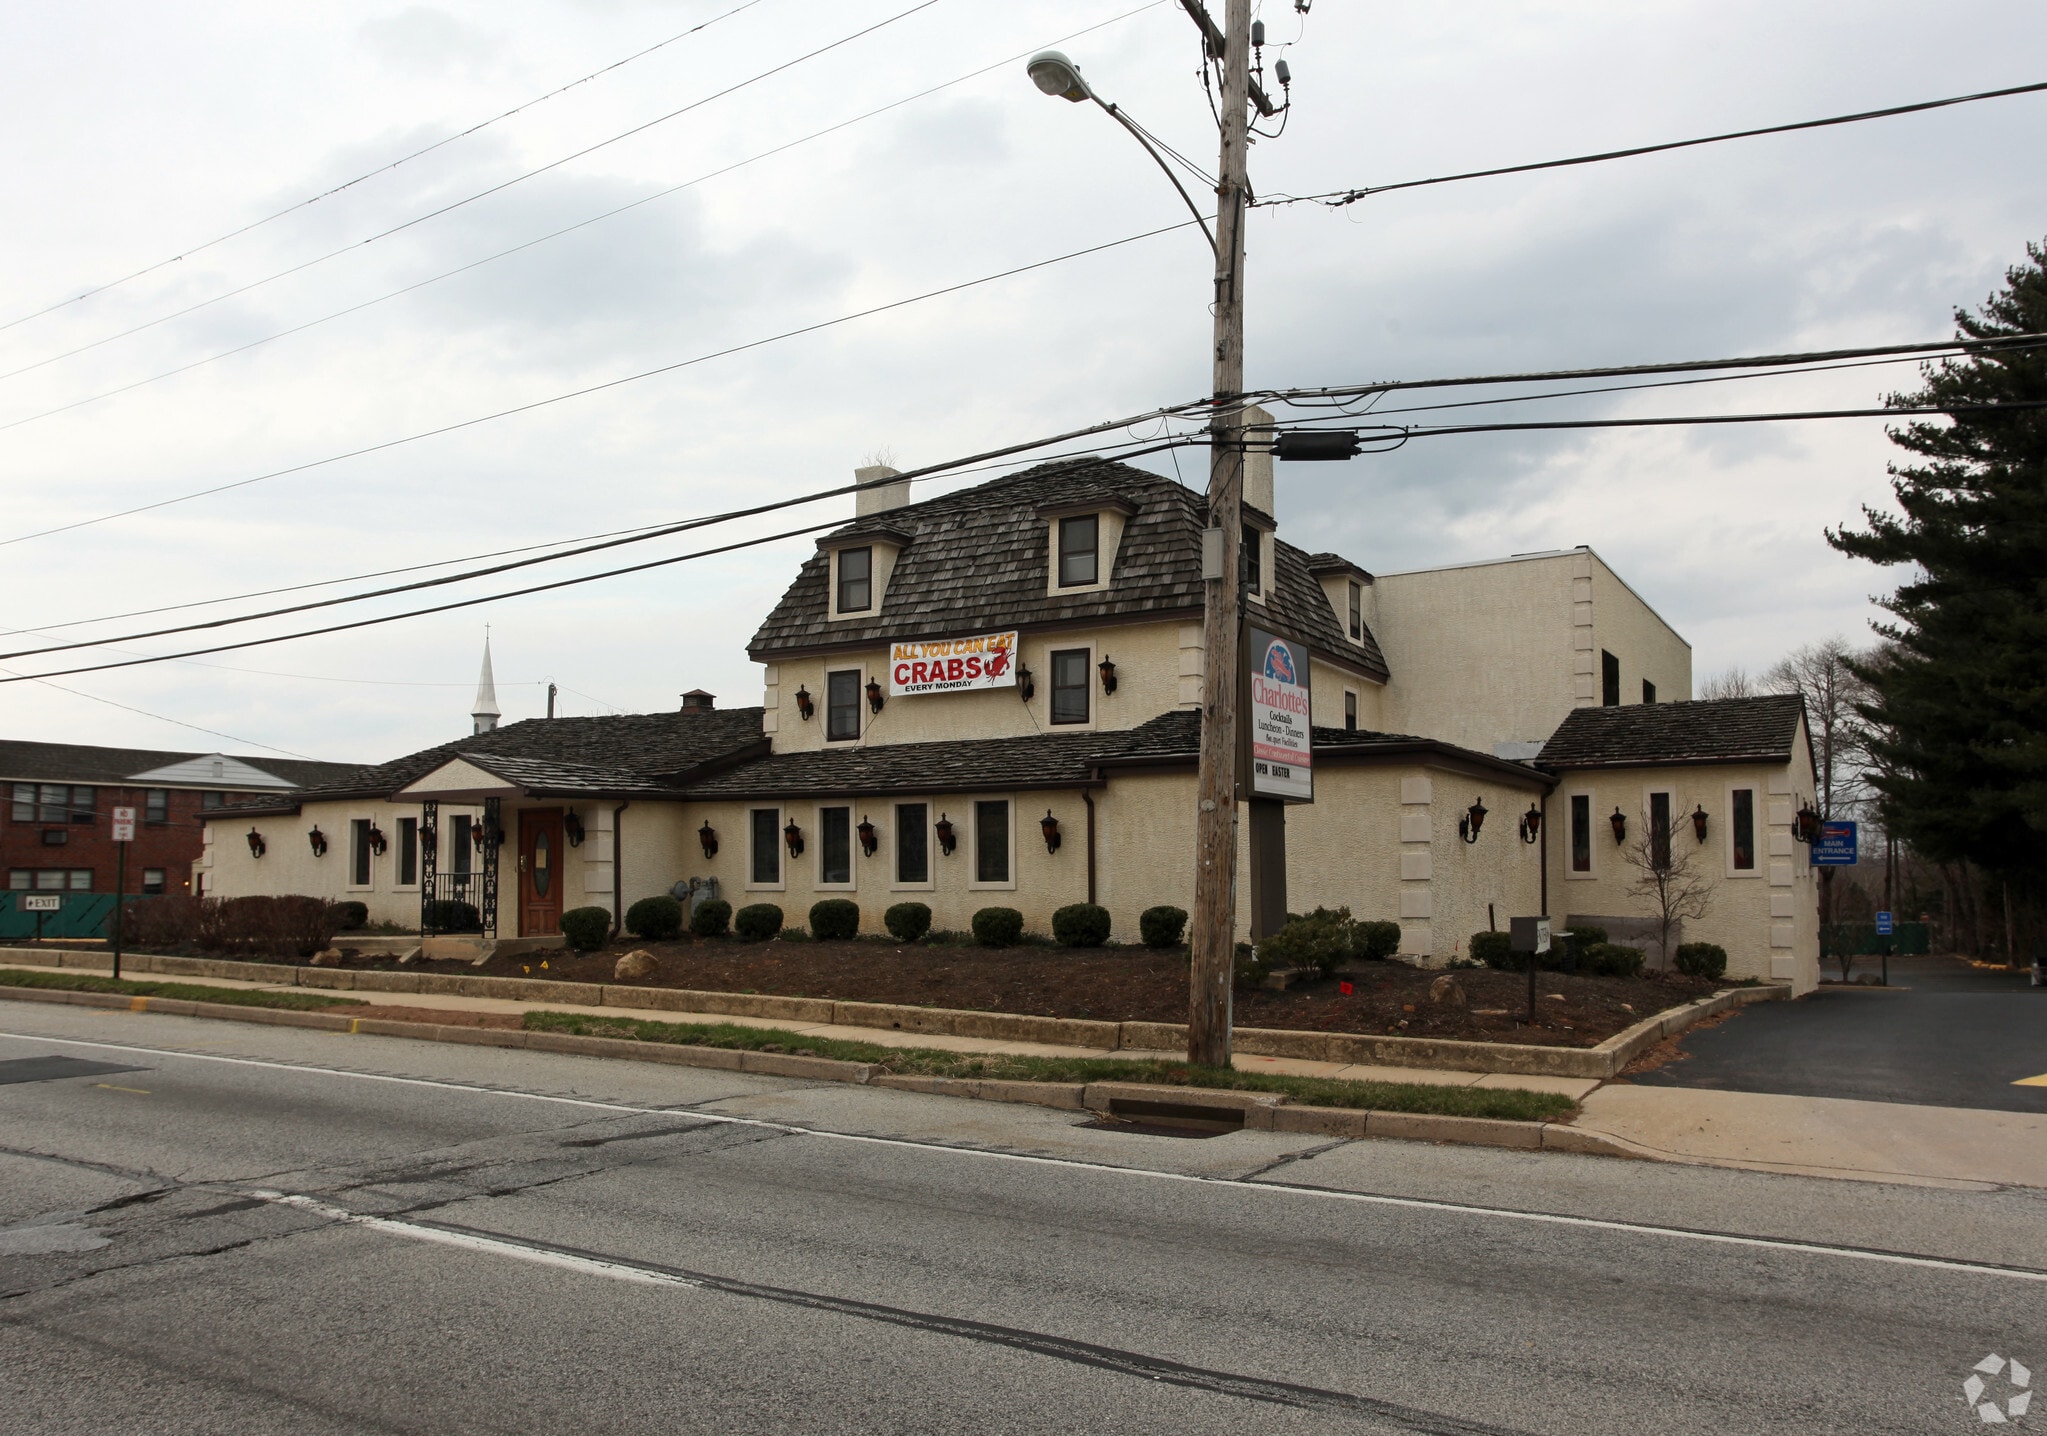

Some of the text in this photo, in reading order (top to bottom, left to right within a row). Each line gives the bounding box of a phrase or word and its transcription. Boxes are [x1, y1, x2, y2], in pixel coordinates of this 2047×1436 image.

[893, 633, 1015, 660] ALL YOU CAN EAT
[894, 657, 982, 685] CRABS
[905, 680, 973, 692] EVERY MONDAY
[1253, 678, 1308, 716] Charlotte's
[1269, 711, 1292, 725] Cocktails
[1258, 719, 1304, 739] Luncheon Dinners
[1265, 734, 1281, 745] Baquet
[1255, 763, 1290, 779] OPEN EASTER
[35, 898, 57, 908] EXIT
